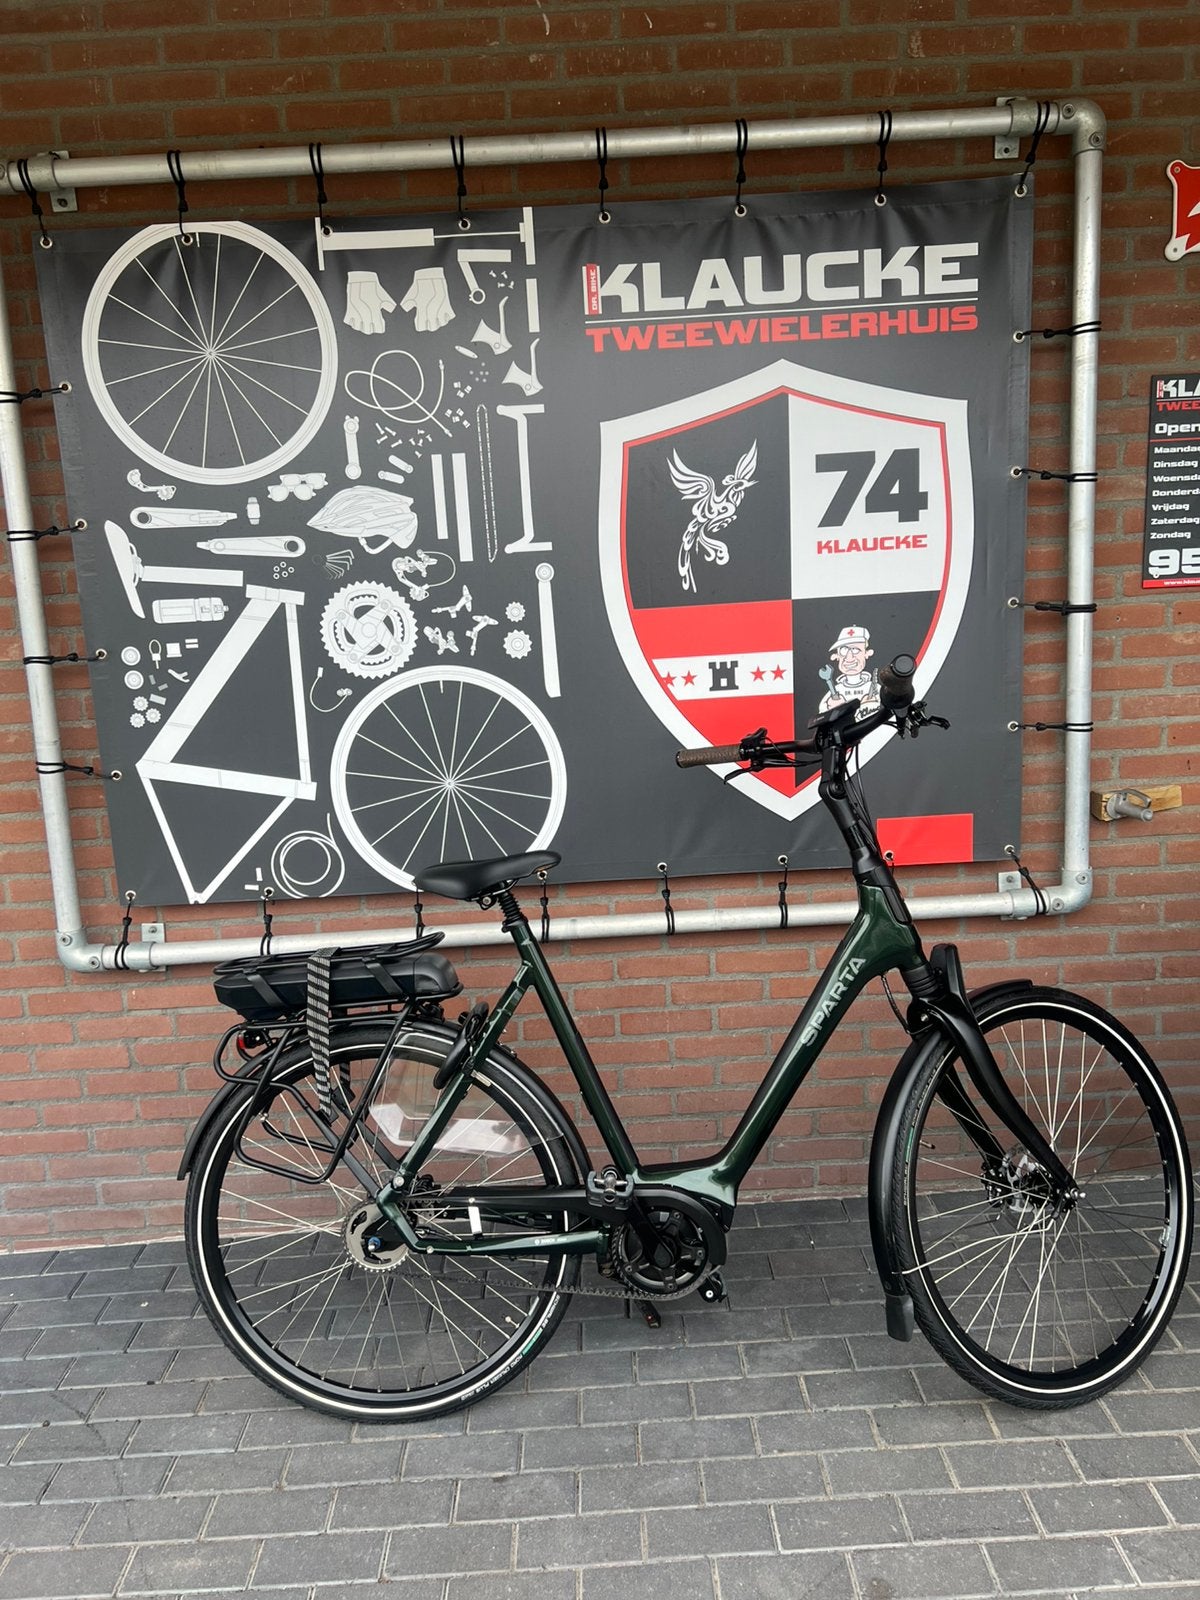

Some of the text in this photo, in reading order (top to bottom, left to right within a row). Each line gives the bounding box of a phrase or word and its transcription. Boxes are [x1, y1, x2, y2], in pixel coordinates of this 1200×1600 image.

[582, 242, 979, 316] KLAUCKE
[585, 305, 978, 353] TWEEWIELERHUIS
[1153, 460, 1199, 468] Dinsdag
[815, 448, 929, 528] 74
[1151, 503, 1190, 512] Vrijdag
[1150, 517, 1200, 525] Zaterdag
[816, 534, 928, 554] KLAUCKE
[1150, 531, 1191, 539] Zondag
[801, 957, 867, 1047] SPARTA
